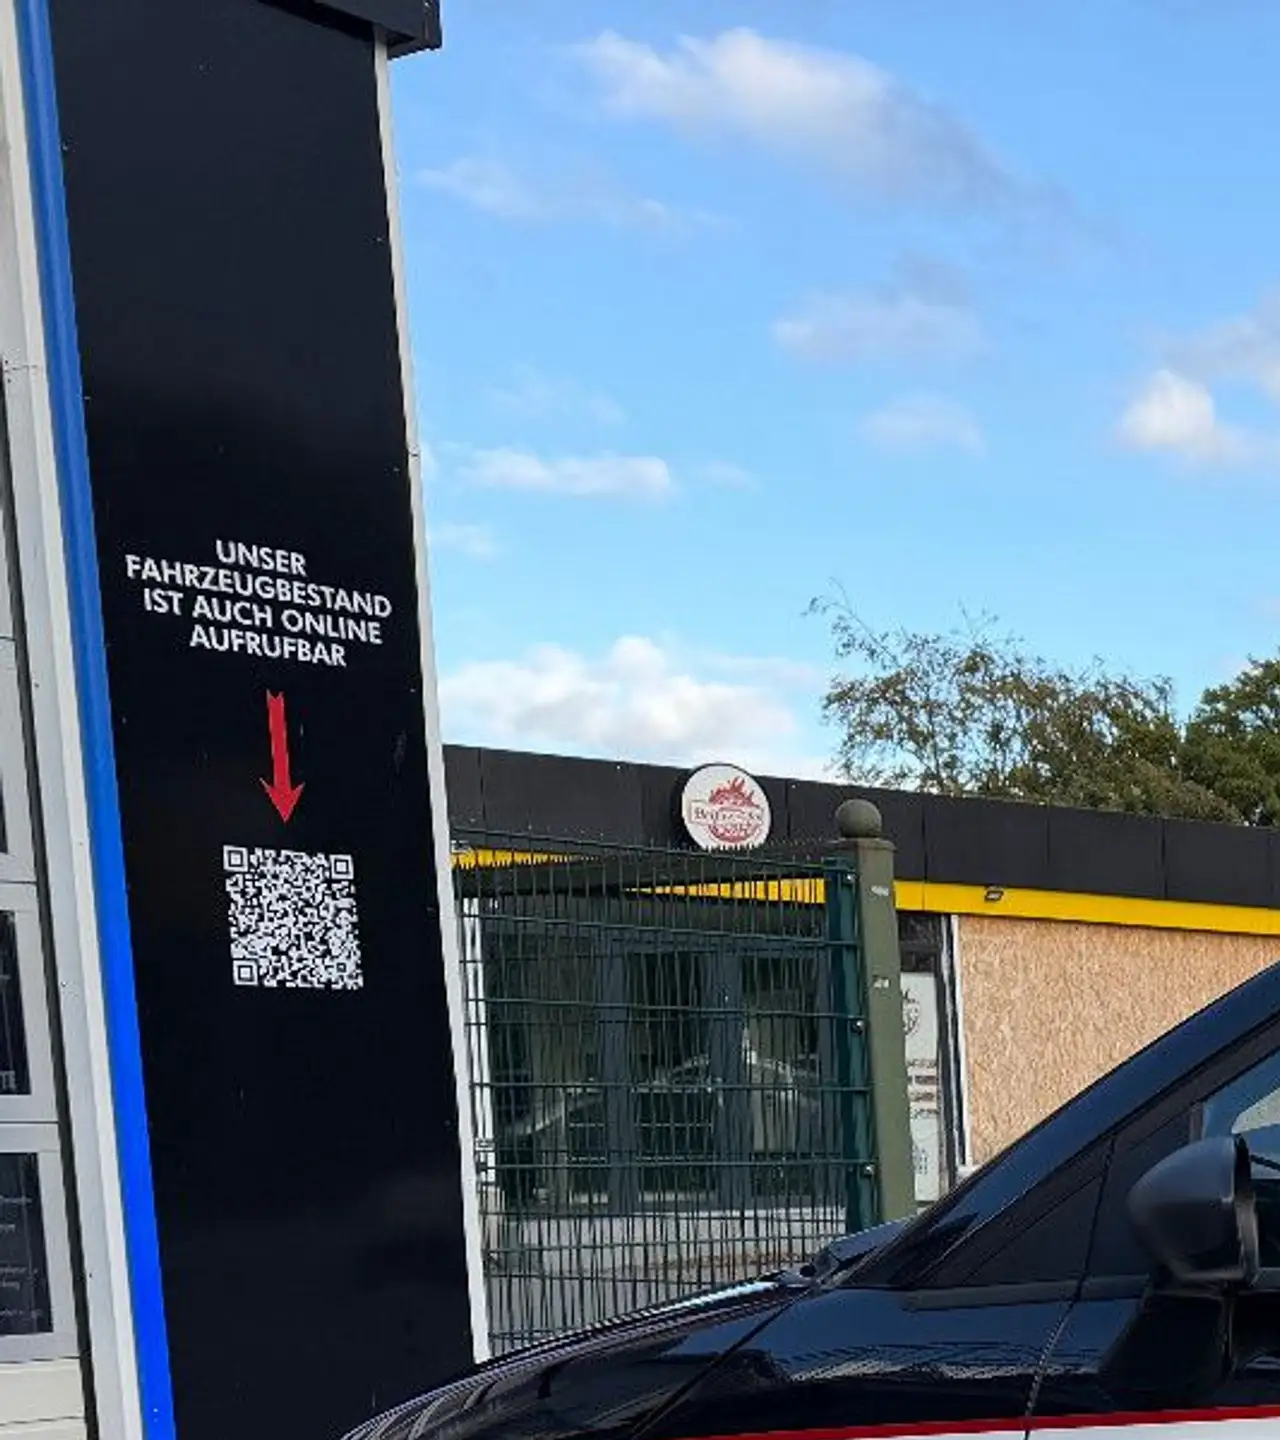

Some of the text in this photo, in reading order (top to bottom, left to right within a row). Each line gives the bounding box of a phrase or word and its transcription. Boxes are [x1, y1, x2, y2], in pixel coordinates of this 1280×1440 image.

[215, 539, 308, 577] UNSER
[125, 554, 393, 618] FAHRZEUGBESTAND
[143, 588, 384, 645] IST AUCH ONLINE
[189, 624, 348, 668] AUFRUFBAR
